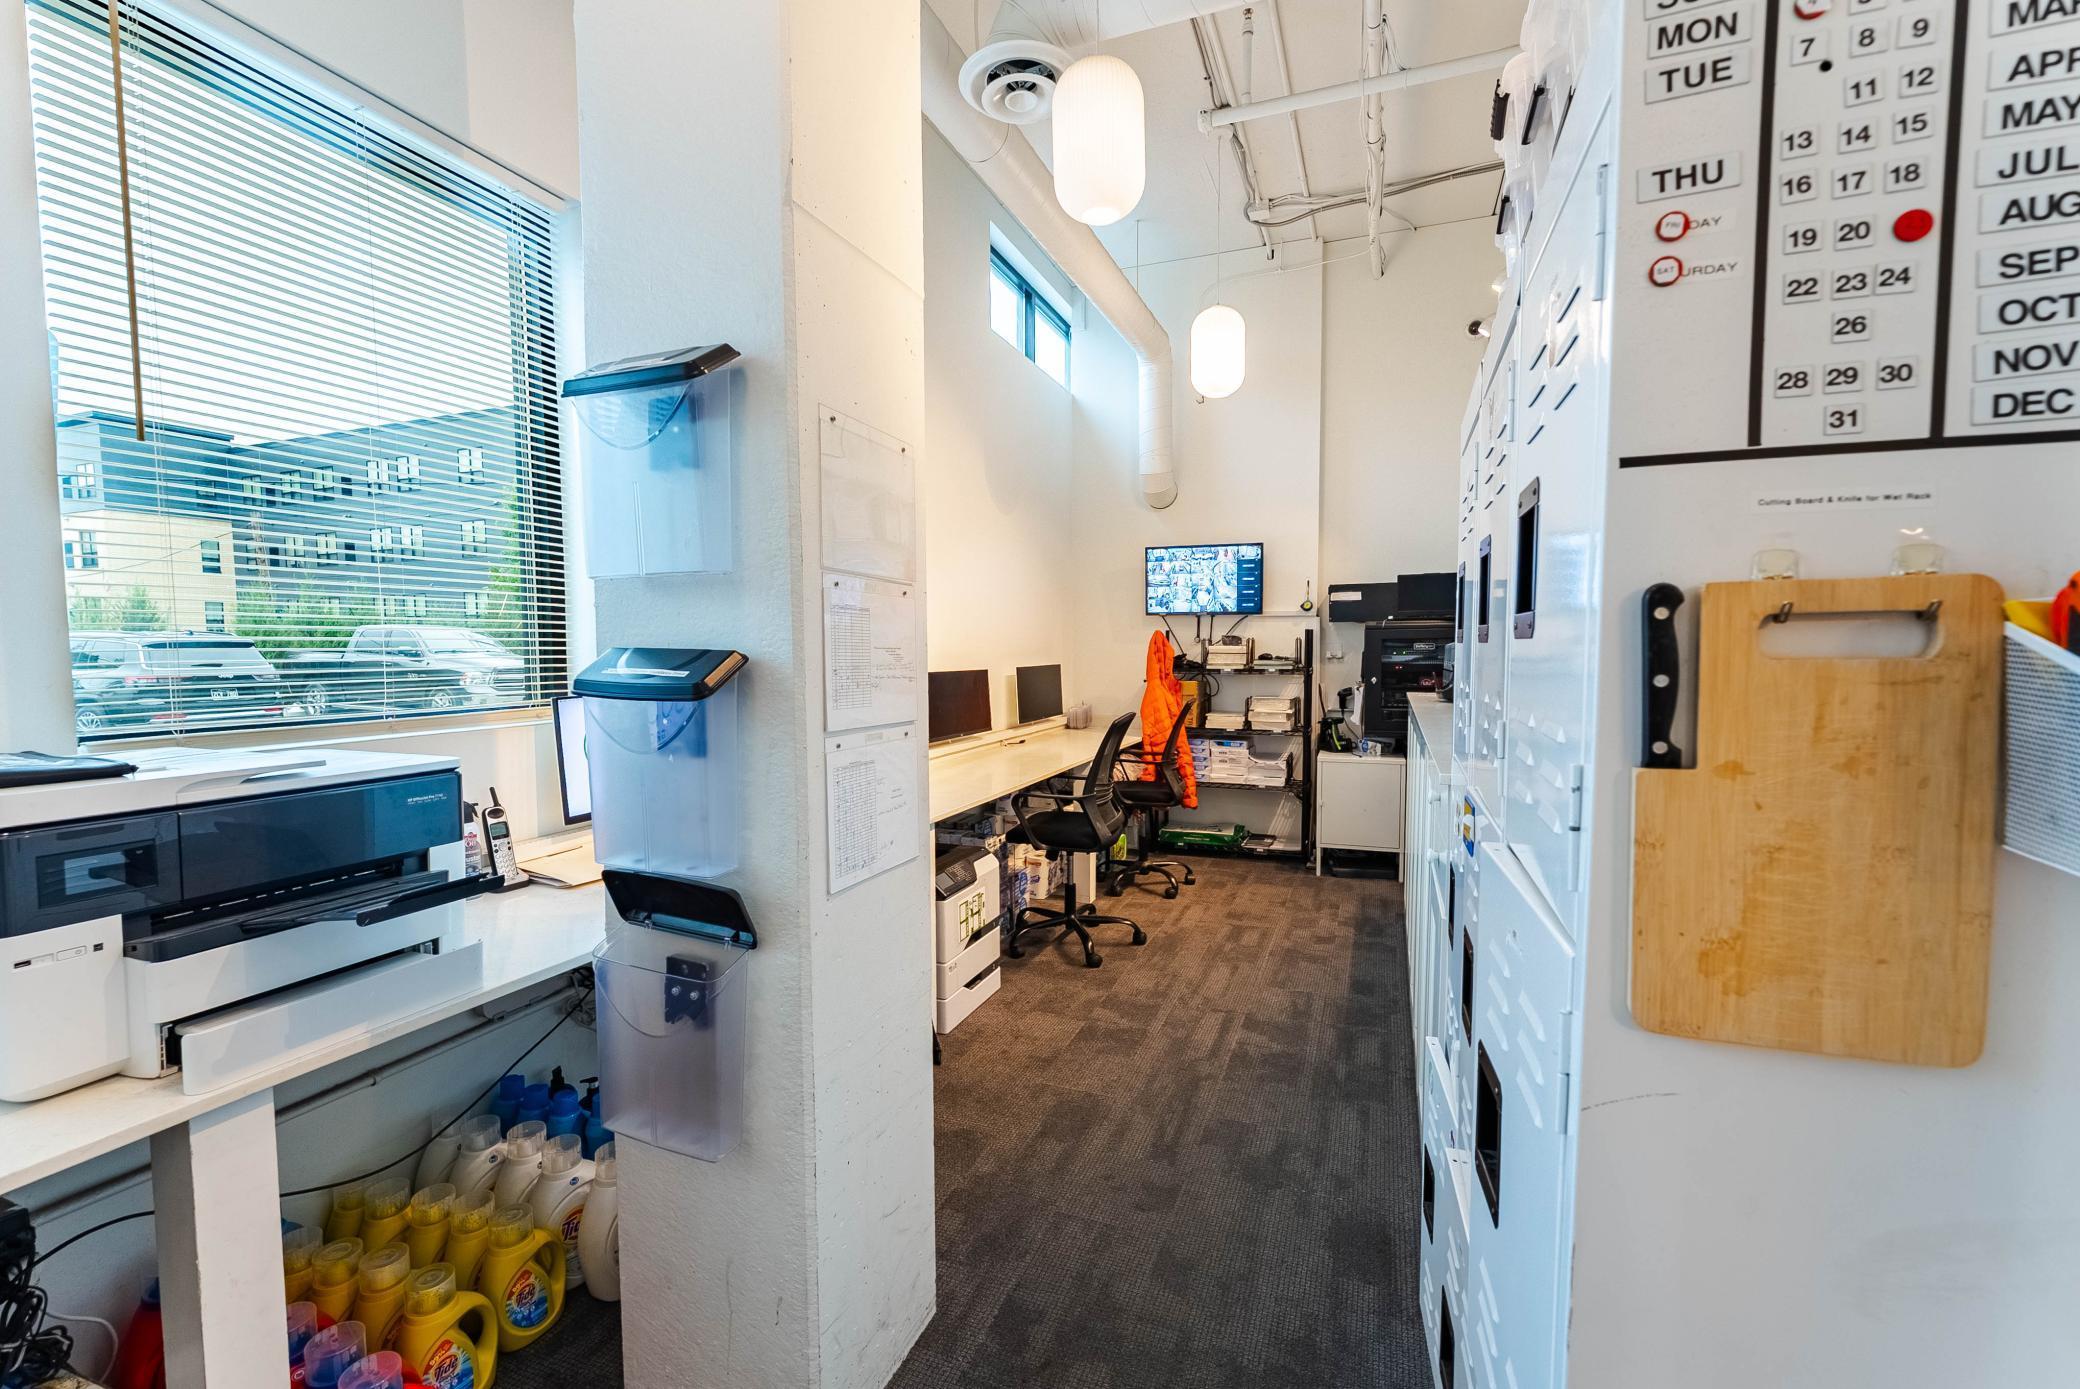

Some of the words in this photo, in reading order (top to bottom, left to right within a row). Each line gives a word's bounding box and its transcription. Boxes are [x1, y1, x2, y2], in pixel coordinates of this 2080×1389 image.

[1657, 11, 1738, 51] MON
[2008, 0, 2080, 28] MA
[1800, 37, 1815, 57] 7
[1858, 28, 1875, 48] 8
[1912, 18, 1929, 38] 9
[1658, 56, 1733, 93] TUE
[1850, 78, 1876, 100] 11
[1903, 66, 1934, 88] 12
[2001, 95, 2080, 130] MAY
[1784, 130, 1813, 152] 13
[1842, 125, 1872, 146] 14
[1897, 112, 1928, 135] 15
[1651, 159, 1724, 194] THU
[1783, 175, 1812, 196] 16
[1837, 170, 1867, 192] 17
[1890, 163, 1921, 184] 18
[1997, 145, 2080, 180] JUL
[1999, 190, 2080, 226] AUG
[1788, 228, 1818, 248] 19
[1837, 220, 1871, 243] 20
[1999, 245, 2080, 280] SEP
[1786, 277, 1819, 298] 22
[1835, 272, 1868, 294] 23
[1878, 266, 1912, 288] 24
[1834, 315, 1867, 336] 26
[1997, 292, 2080, 326] OCT
[1994, 340, 2080, 375] NOV
[1776, 370, 1809, 391] 28
[1825, 366, 1859, 387] 29
[1879, 363, 1913, 384] 30
[1828, 409, 1858, 429] 31
[1991, 387, 2075, 423] DEC
[434, 1355, 459, 1383] Tide
